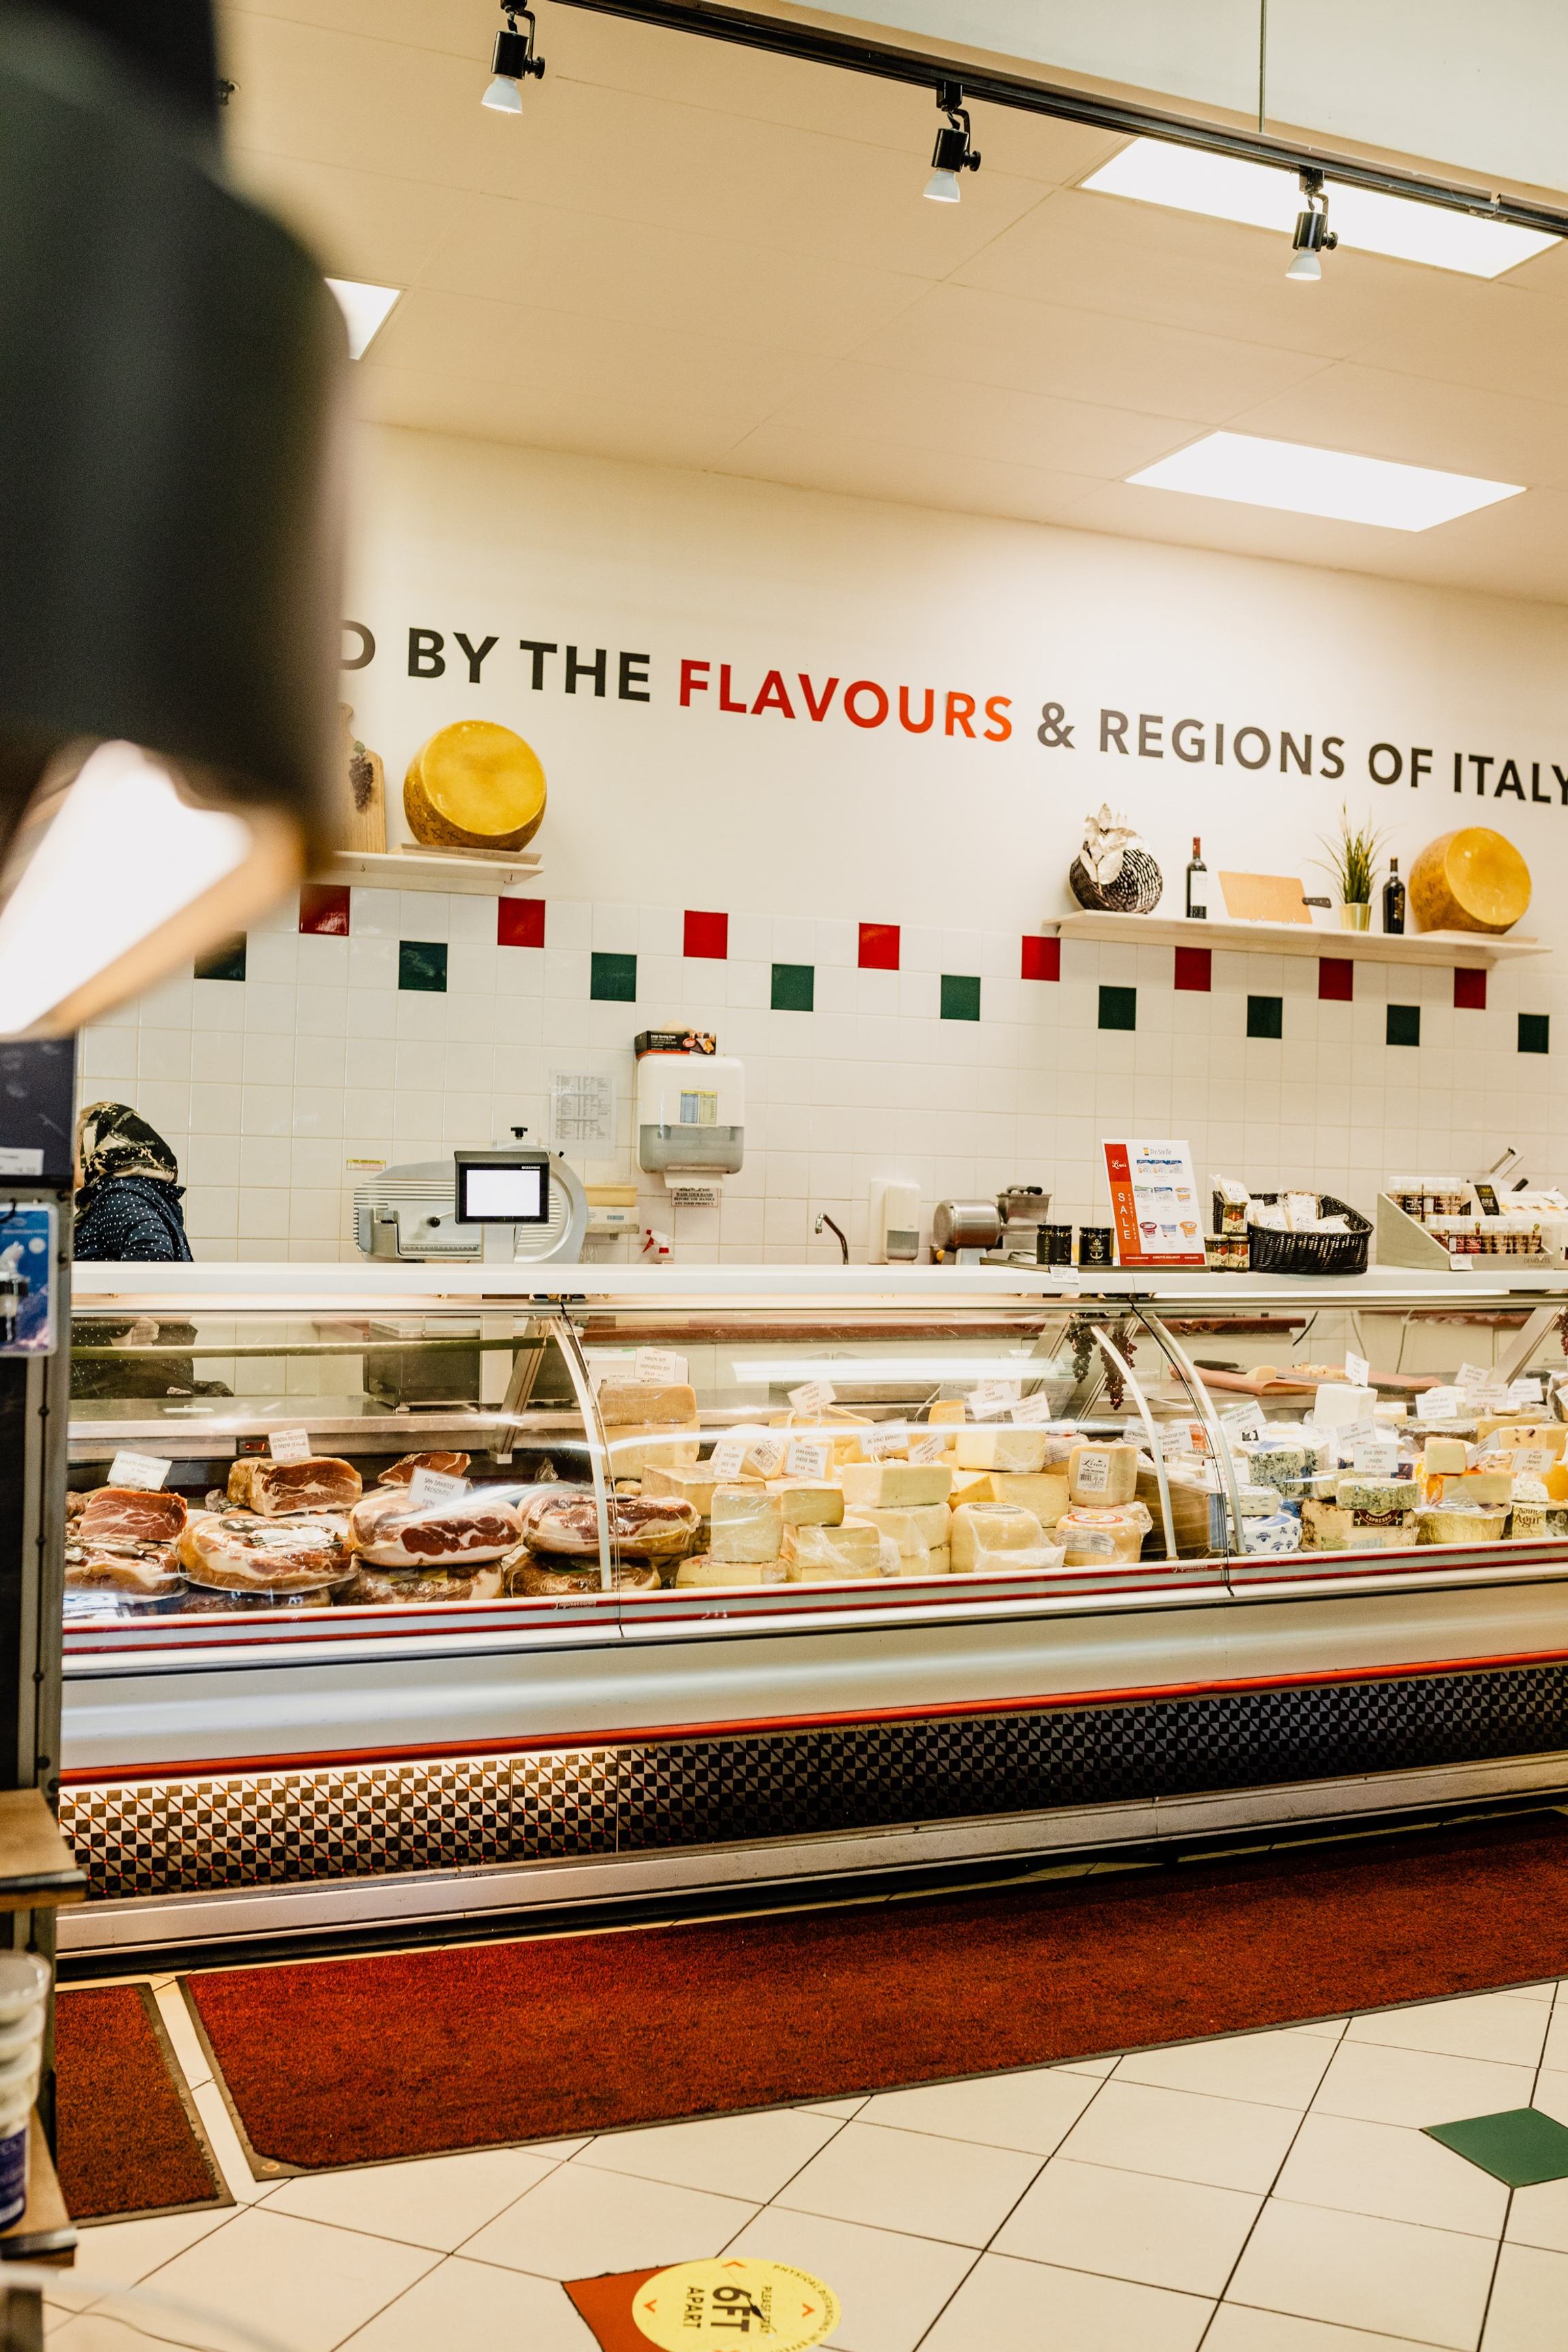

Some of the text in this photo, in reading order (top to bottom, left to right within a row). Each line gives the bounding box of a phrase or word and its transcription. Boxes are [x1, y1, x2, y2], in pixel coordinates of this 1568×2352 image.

[408, 627, 500, 684] BY
[519, 640, 651, 702] THE
[680, 658, 1012, 742] FLAVOURS
[1038, 702, 1075, 749] &
[1100, 708, 1345, 779] REGIONS
[1368, 742, 1433, 788] OF
[1454, 752, 1568, 806] ITALY
[1117, 1192, 1131, 1240] SALE
[1365, 1514, 1392, 1524] ESPRESSO
[1514, 1513, 1542, 1528] Agur
[683, 2285, 705, 2330] APART
[710, 2286, 752, 2332] 6FT
